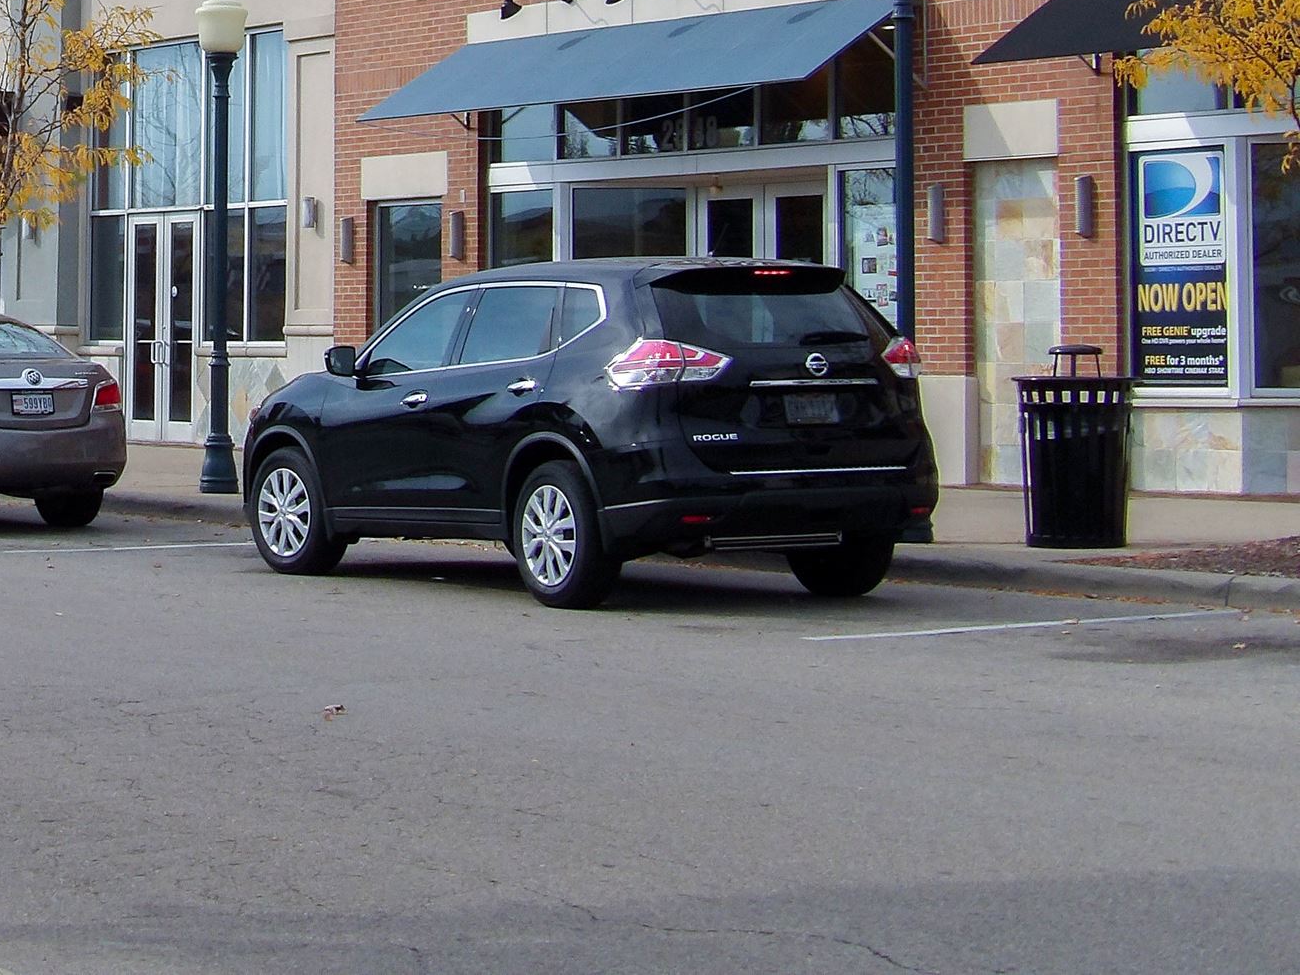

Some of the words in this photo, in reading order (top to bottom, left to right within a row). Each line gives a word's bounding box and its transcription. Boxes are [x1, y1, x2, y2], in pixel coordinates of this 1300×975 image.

[1144, 221, 1221, 244] DIRECTV
[1144, 250, 1190, 261] AUTHORIZED
[1192, 248, 1223, 259] DEALER
[1138, 283, 1179, 312] NOW
[1182, 282, 1229, 312] OPEN
[1141, 327, 1162, 337] FREE
[1190, 325, 1227, 338] upgrade
[1145, 355, 1166, 366] FREE
[1166, 355, 1179, 365] for
[1180, 356, 1186, 365] 3
[693, 433, 738, 441] ROGUE
